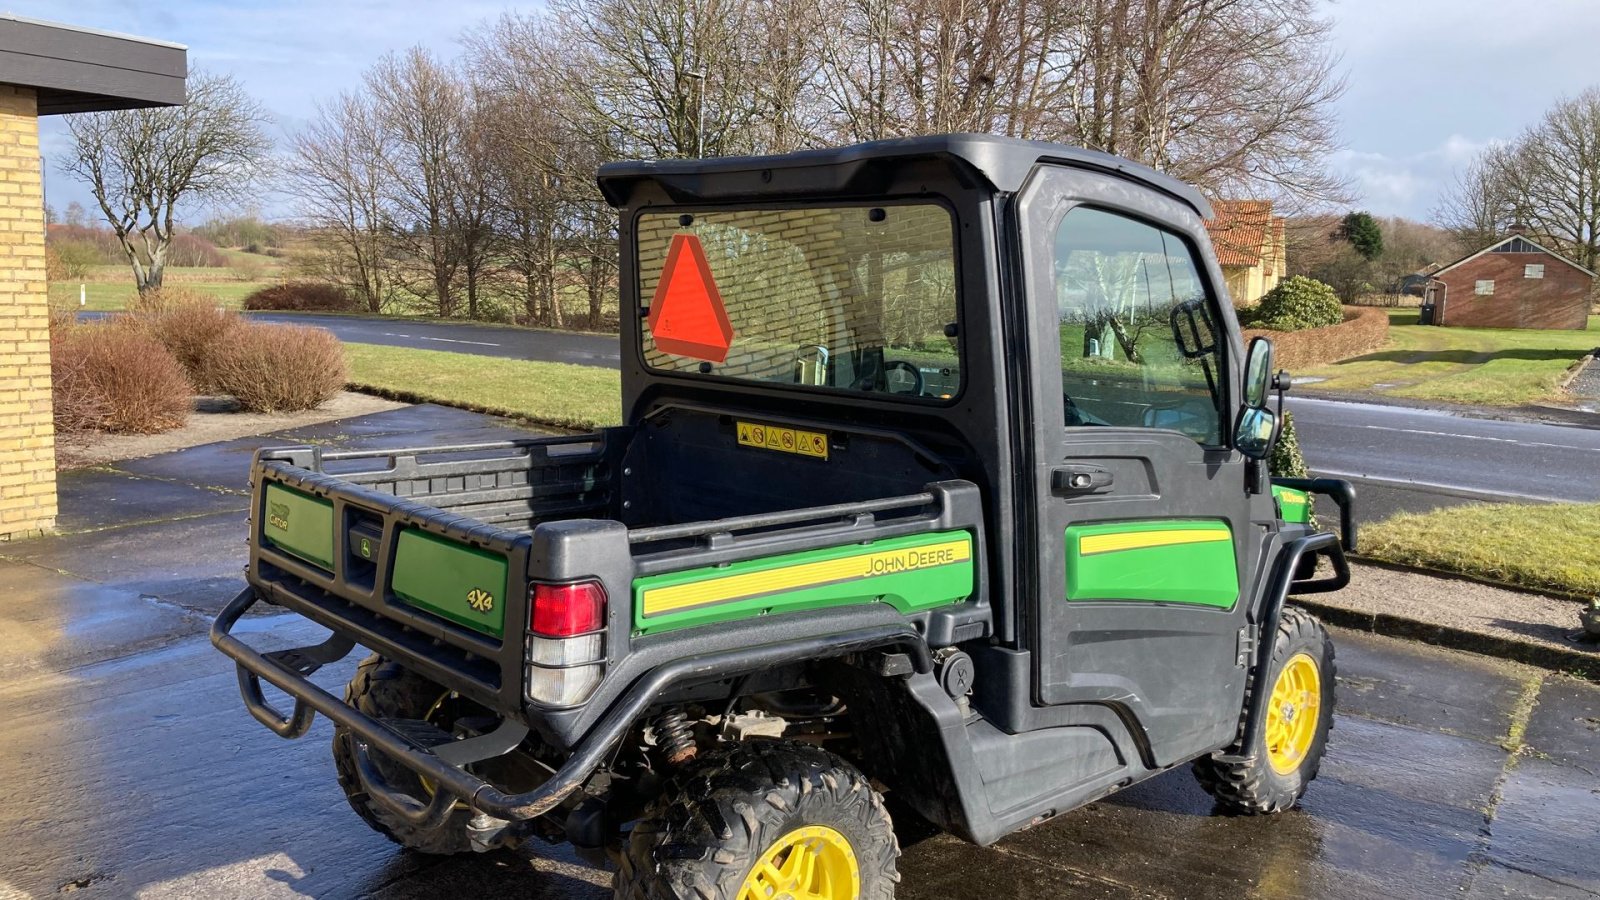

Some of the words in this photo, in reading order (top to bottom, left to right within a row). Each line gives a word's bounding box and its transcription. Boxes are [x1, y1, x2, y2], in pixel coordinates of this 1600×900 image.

[865, 556, 905, 574] JOHN
[908, 550, 954, 567] DEERE
[467, 589, 493, 611] 4X4
